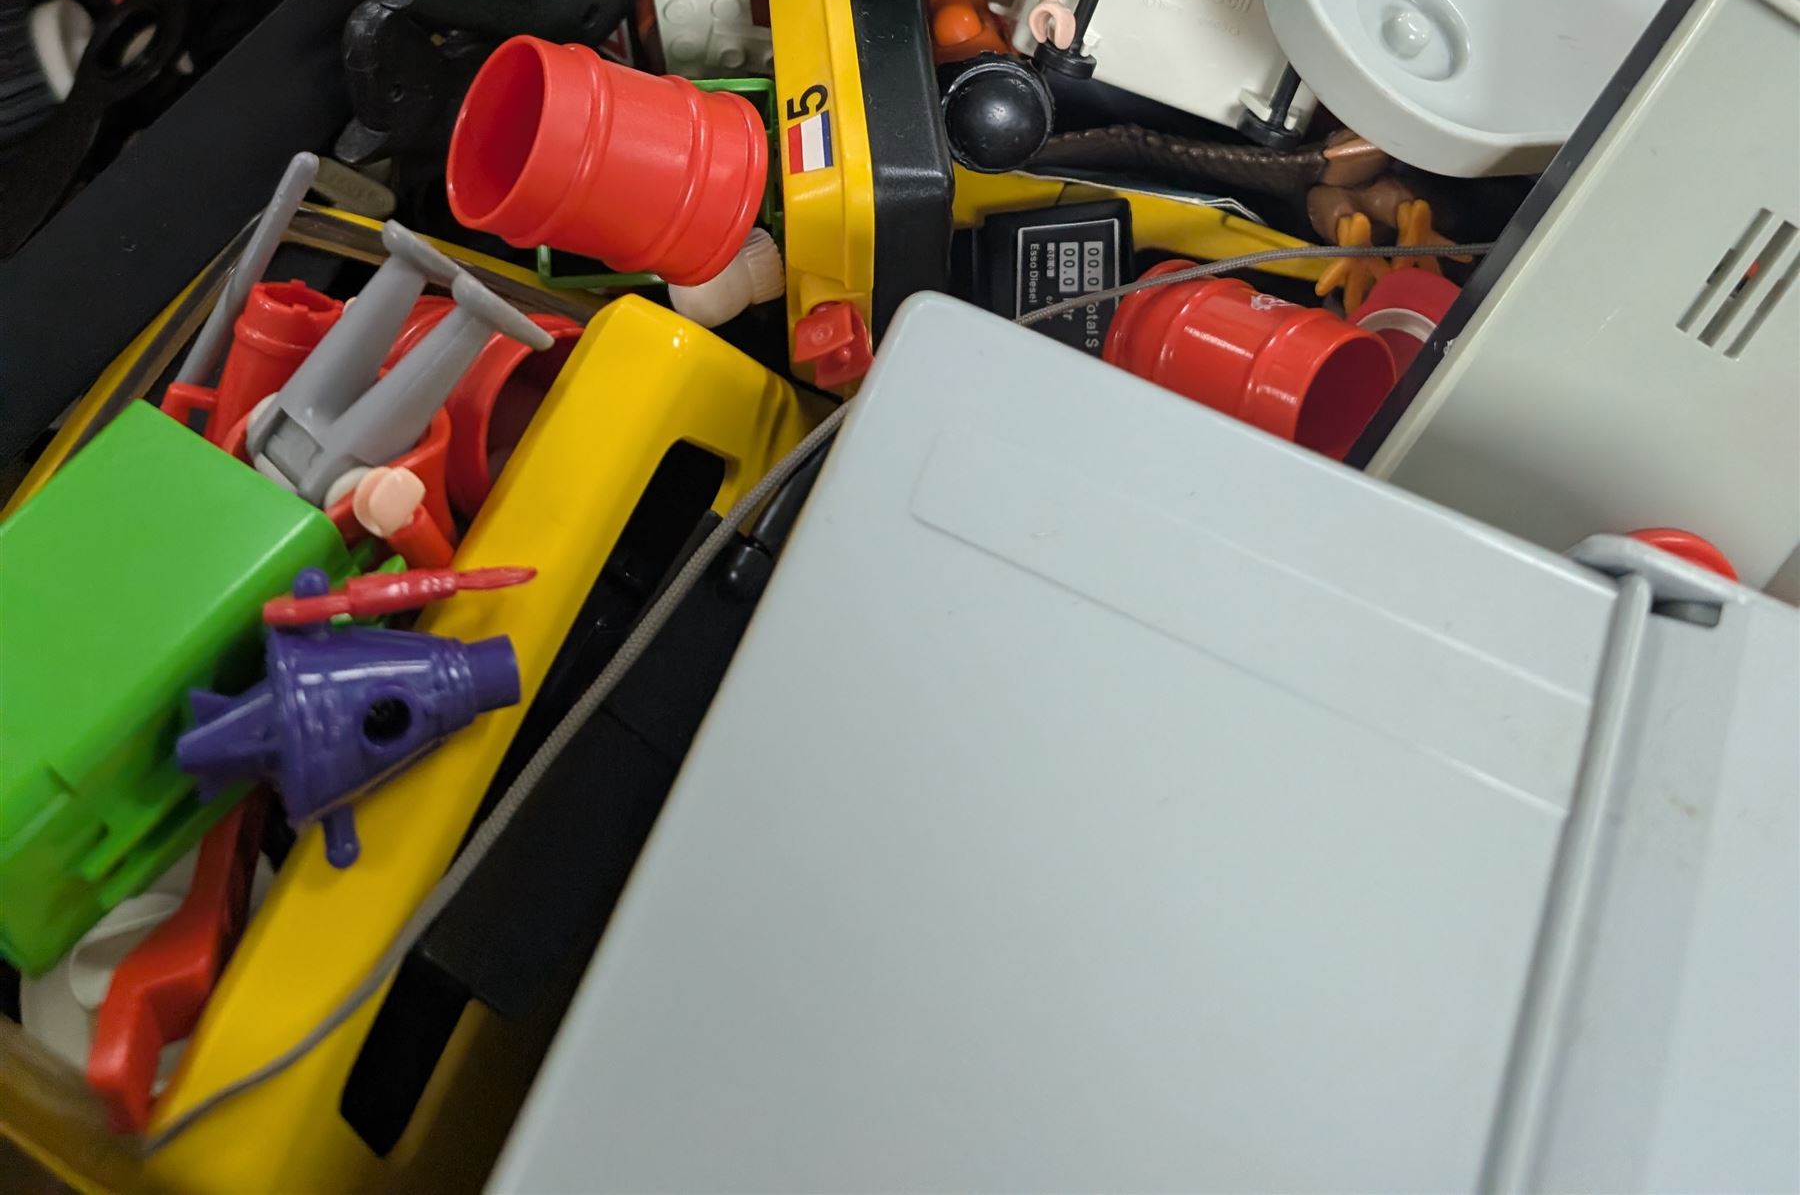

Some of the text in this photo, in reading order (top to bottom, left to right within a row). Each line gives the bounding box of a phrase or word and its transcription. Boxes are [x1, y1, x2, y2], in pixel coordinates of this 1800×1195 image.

[786, 84, 828, 120] 5
[1029, 243, 1039, 303] Esso Diesel
[1063, 248, 1075, 286] 00.0
[1087, 248, 1099, 286] 00.0
